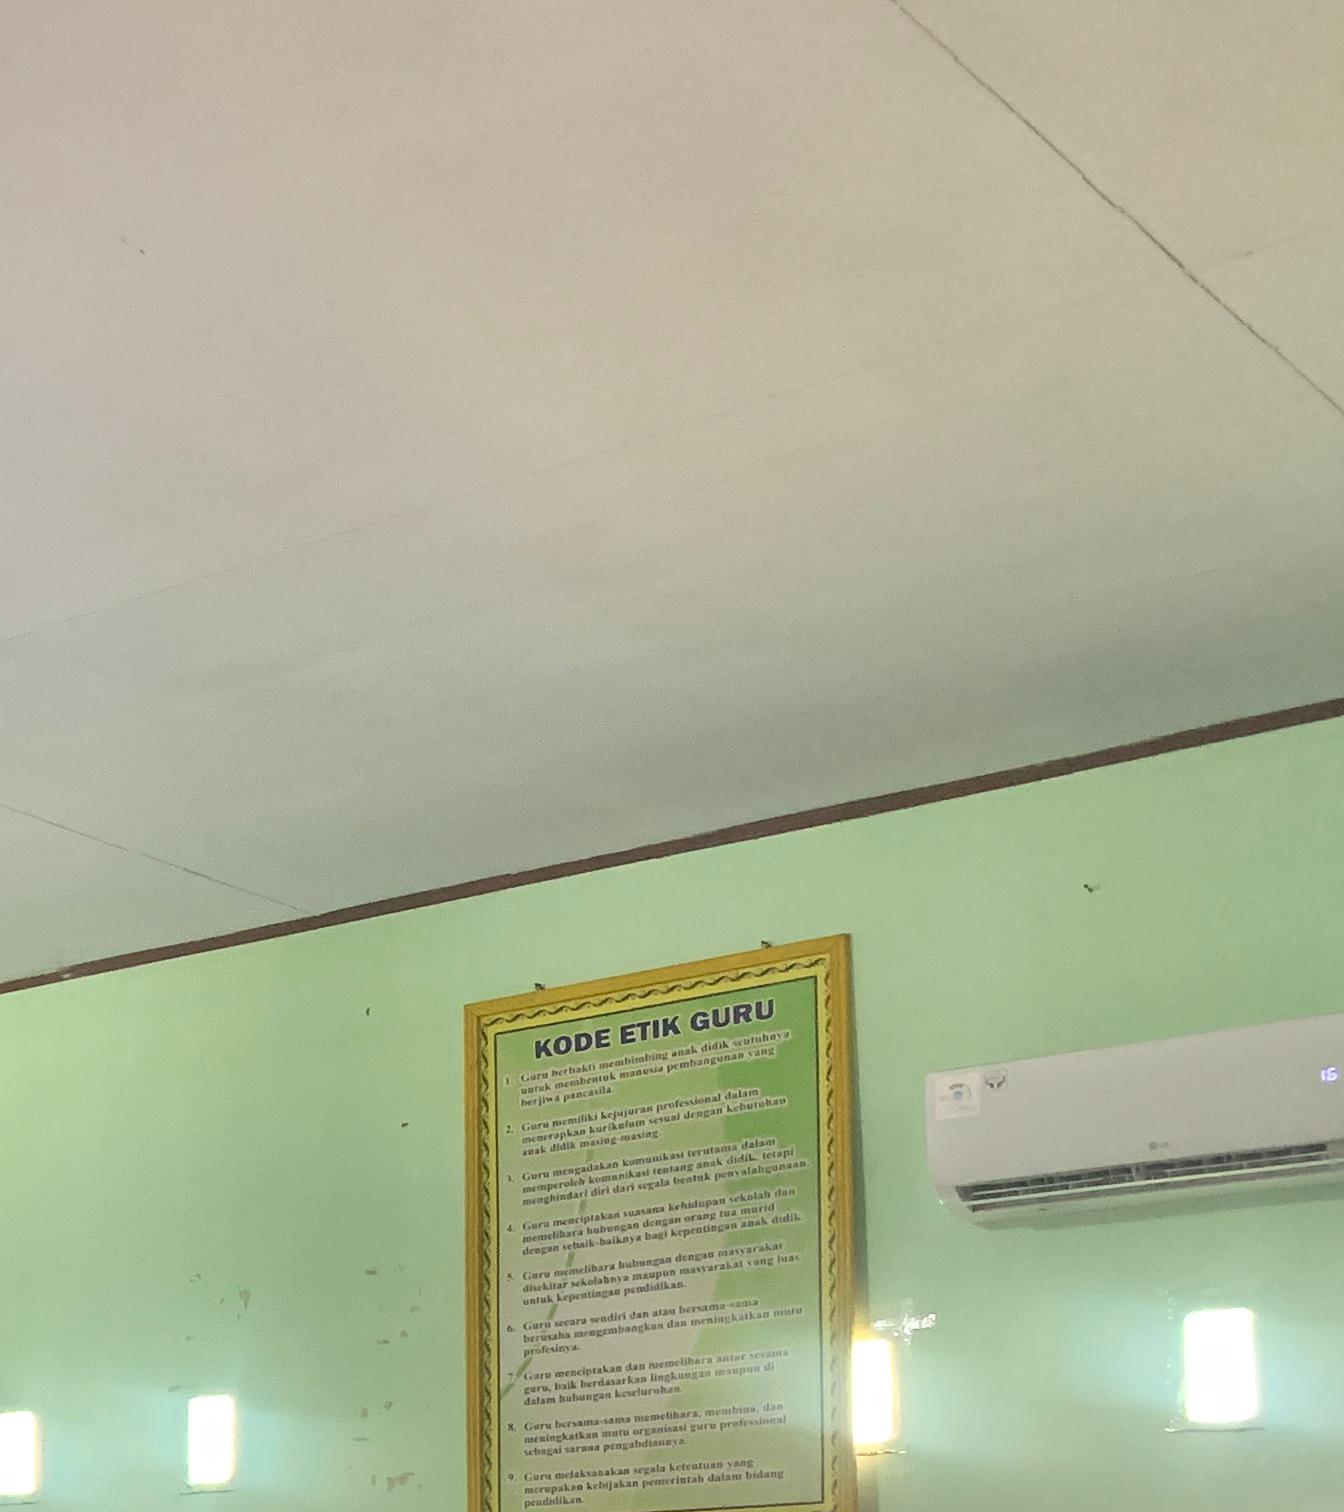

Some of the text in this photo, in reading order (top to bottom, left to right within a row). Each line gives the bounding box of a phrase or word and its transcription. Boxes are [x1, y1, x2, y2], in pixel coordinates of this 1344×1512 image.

[534, 999, 774, 1059] KODE ETIK GURU
